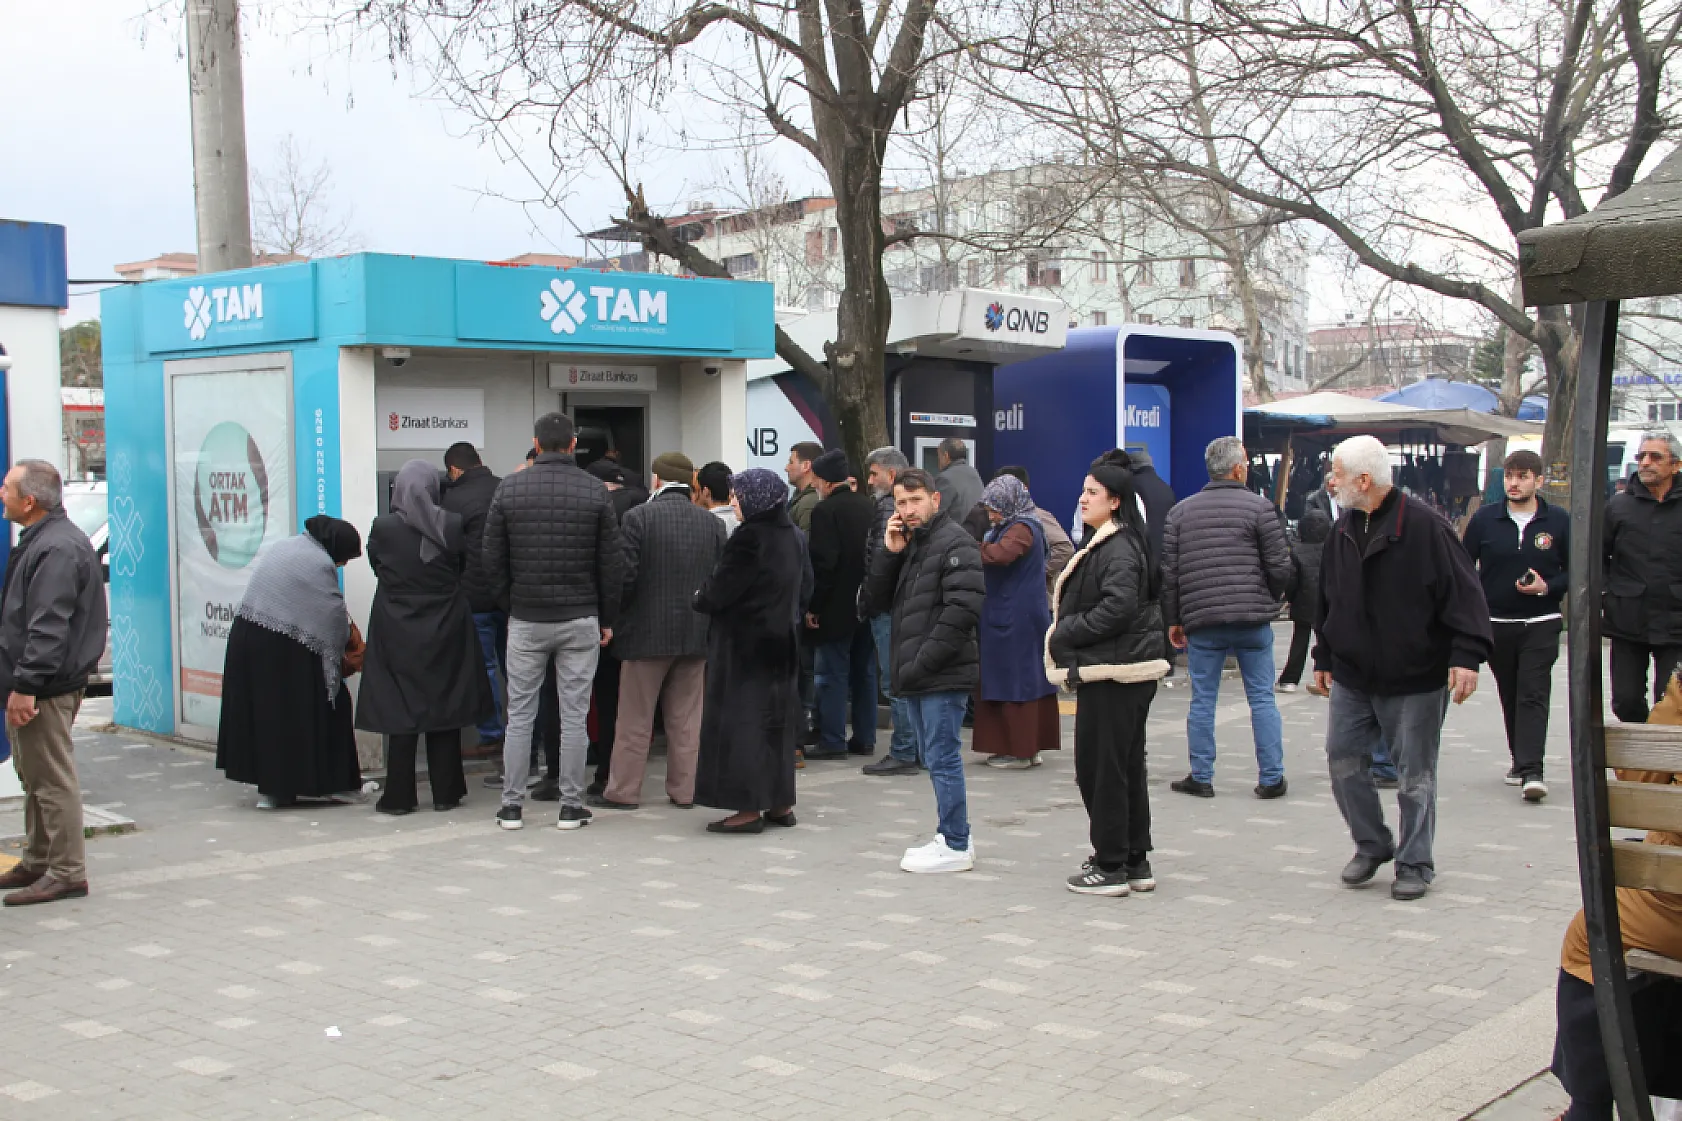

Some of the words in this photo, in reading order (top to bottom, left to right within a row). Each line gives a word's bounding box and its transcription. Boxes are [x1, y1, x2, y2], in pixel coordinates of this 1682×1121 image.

[211, 283, 263, 323] TAM
[589, 285, 668, 325] TAM
[1006, 307, 1049, 333] QNB
[580, 370, 605, 382] Ziraat
[314, 408, 323, 434] 826
[401, 415, 431, 429] Ziraat
[432, 416, 469, 429] Bankası
[995, 403, 1024, 431] edi
[316, 437, 323, 447] 0
[746, 427, 779, 457] NB
[316, 450, 324, 475] 222
[209, 471, 246, 490] ORTAK
[208, 491, 248, 524] ATM
[205, 601, 235, 621] Ortak
